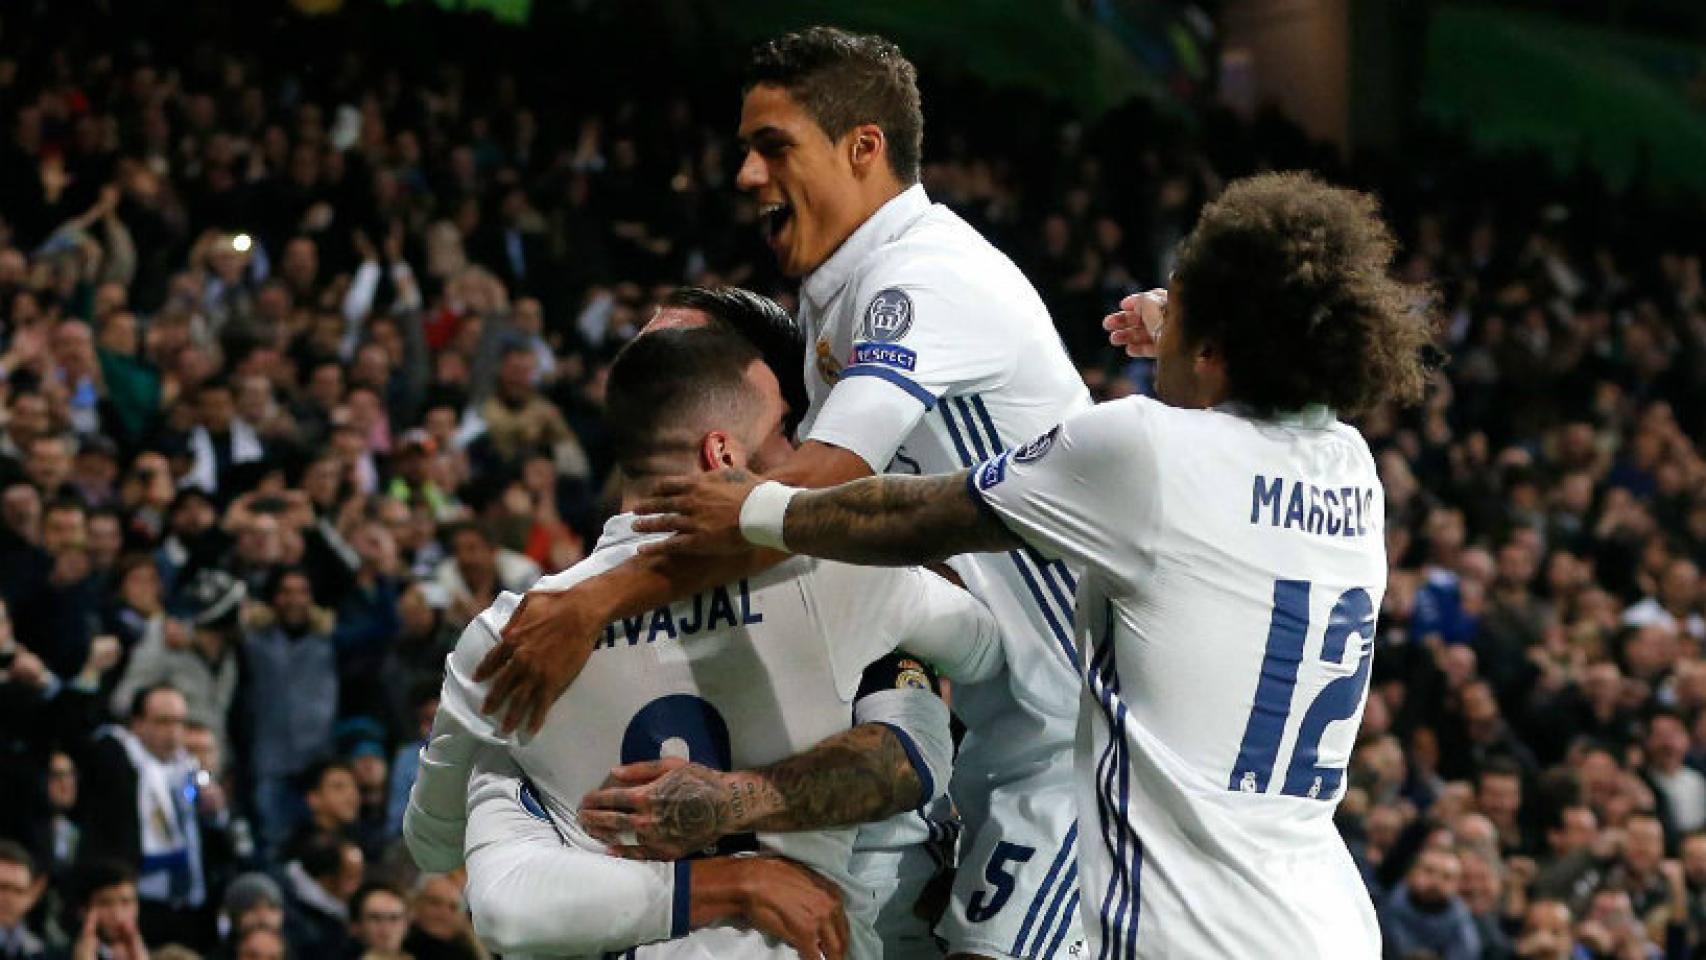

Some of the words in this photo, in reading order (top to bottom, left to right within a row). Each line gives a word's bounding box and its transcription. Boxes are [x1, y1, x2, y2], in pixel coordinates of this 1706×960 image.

[857, 348, 915, 367] RESPECT
[1227, 579, 1374, 800] 12
[966, 841, 1037, 923] 5
